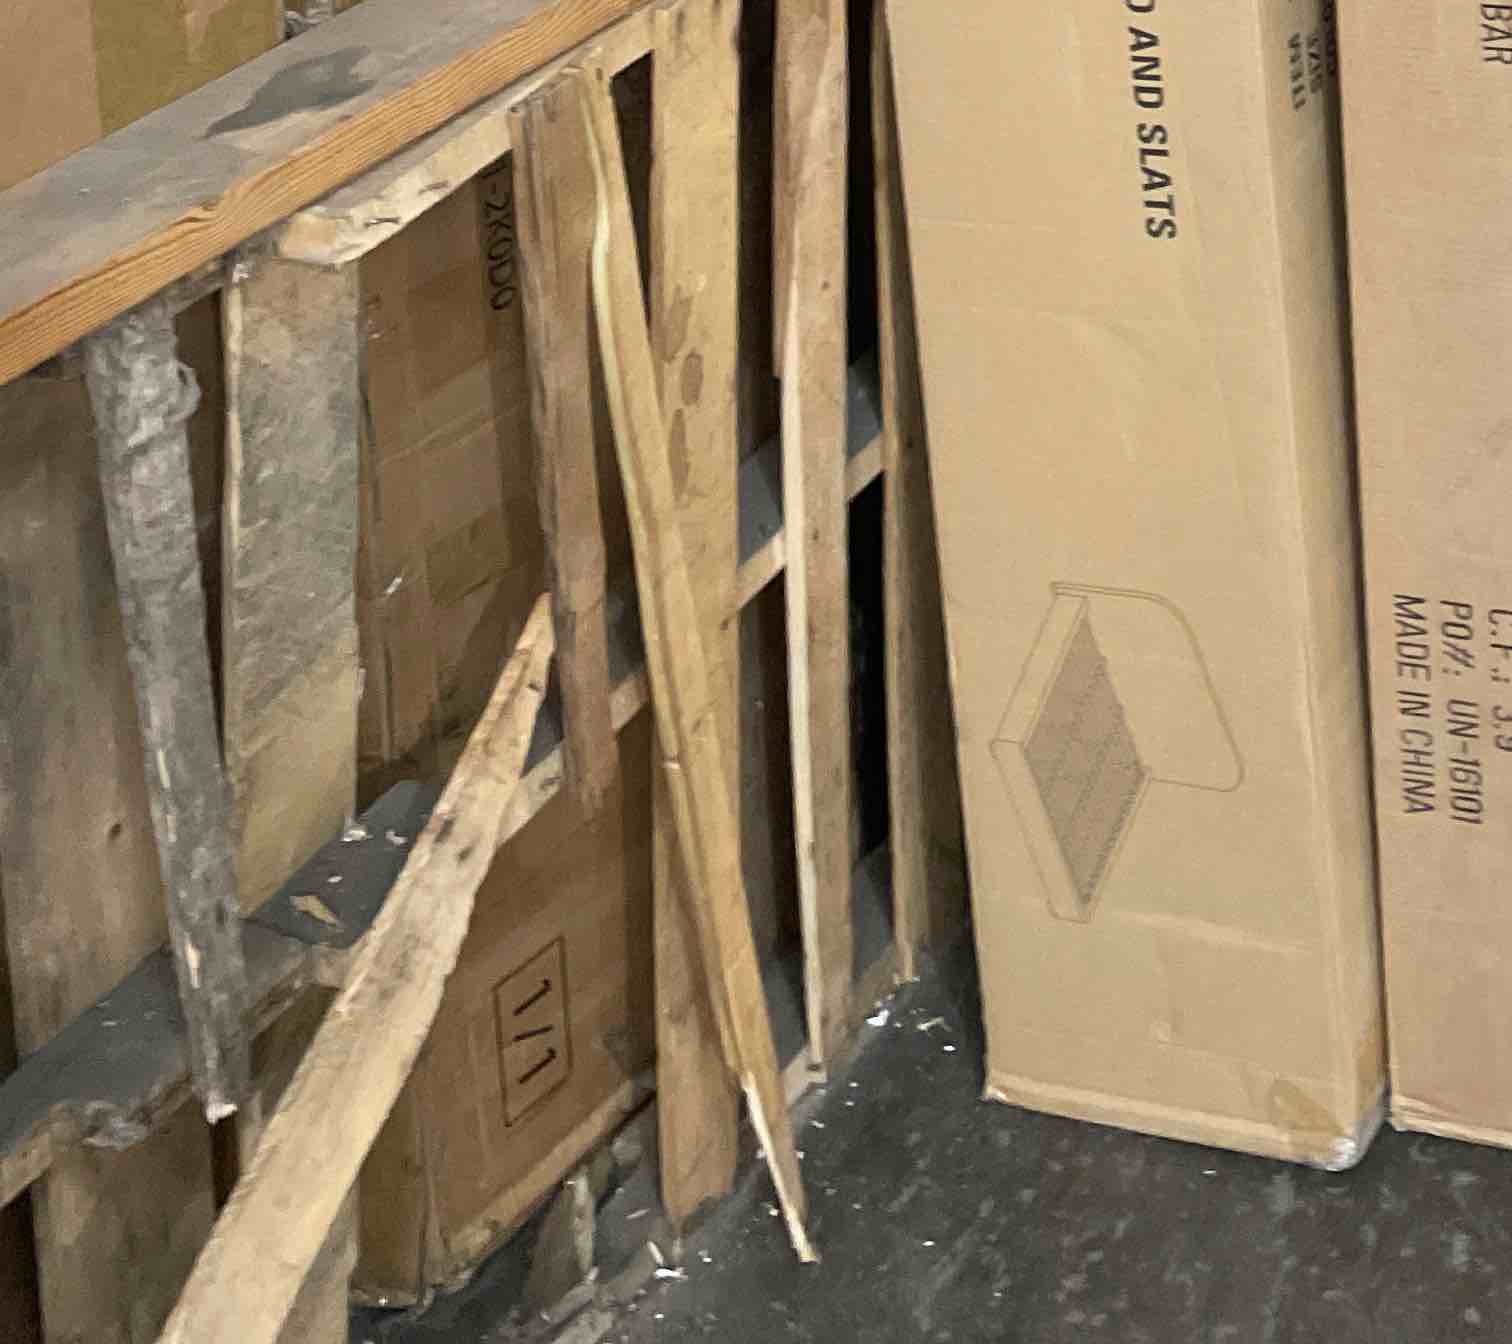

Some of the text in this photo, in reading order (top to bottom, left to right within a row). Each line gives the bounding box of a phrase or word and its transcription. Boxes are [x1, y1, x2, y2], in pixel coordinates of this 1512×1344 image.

[1127, 25, 1165, 111] AND
[1136, 121, 1177, 241] SLATS
[1392, 593, 1436, 815] MADE IN CHINA
